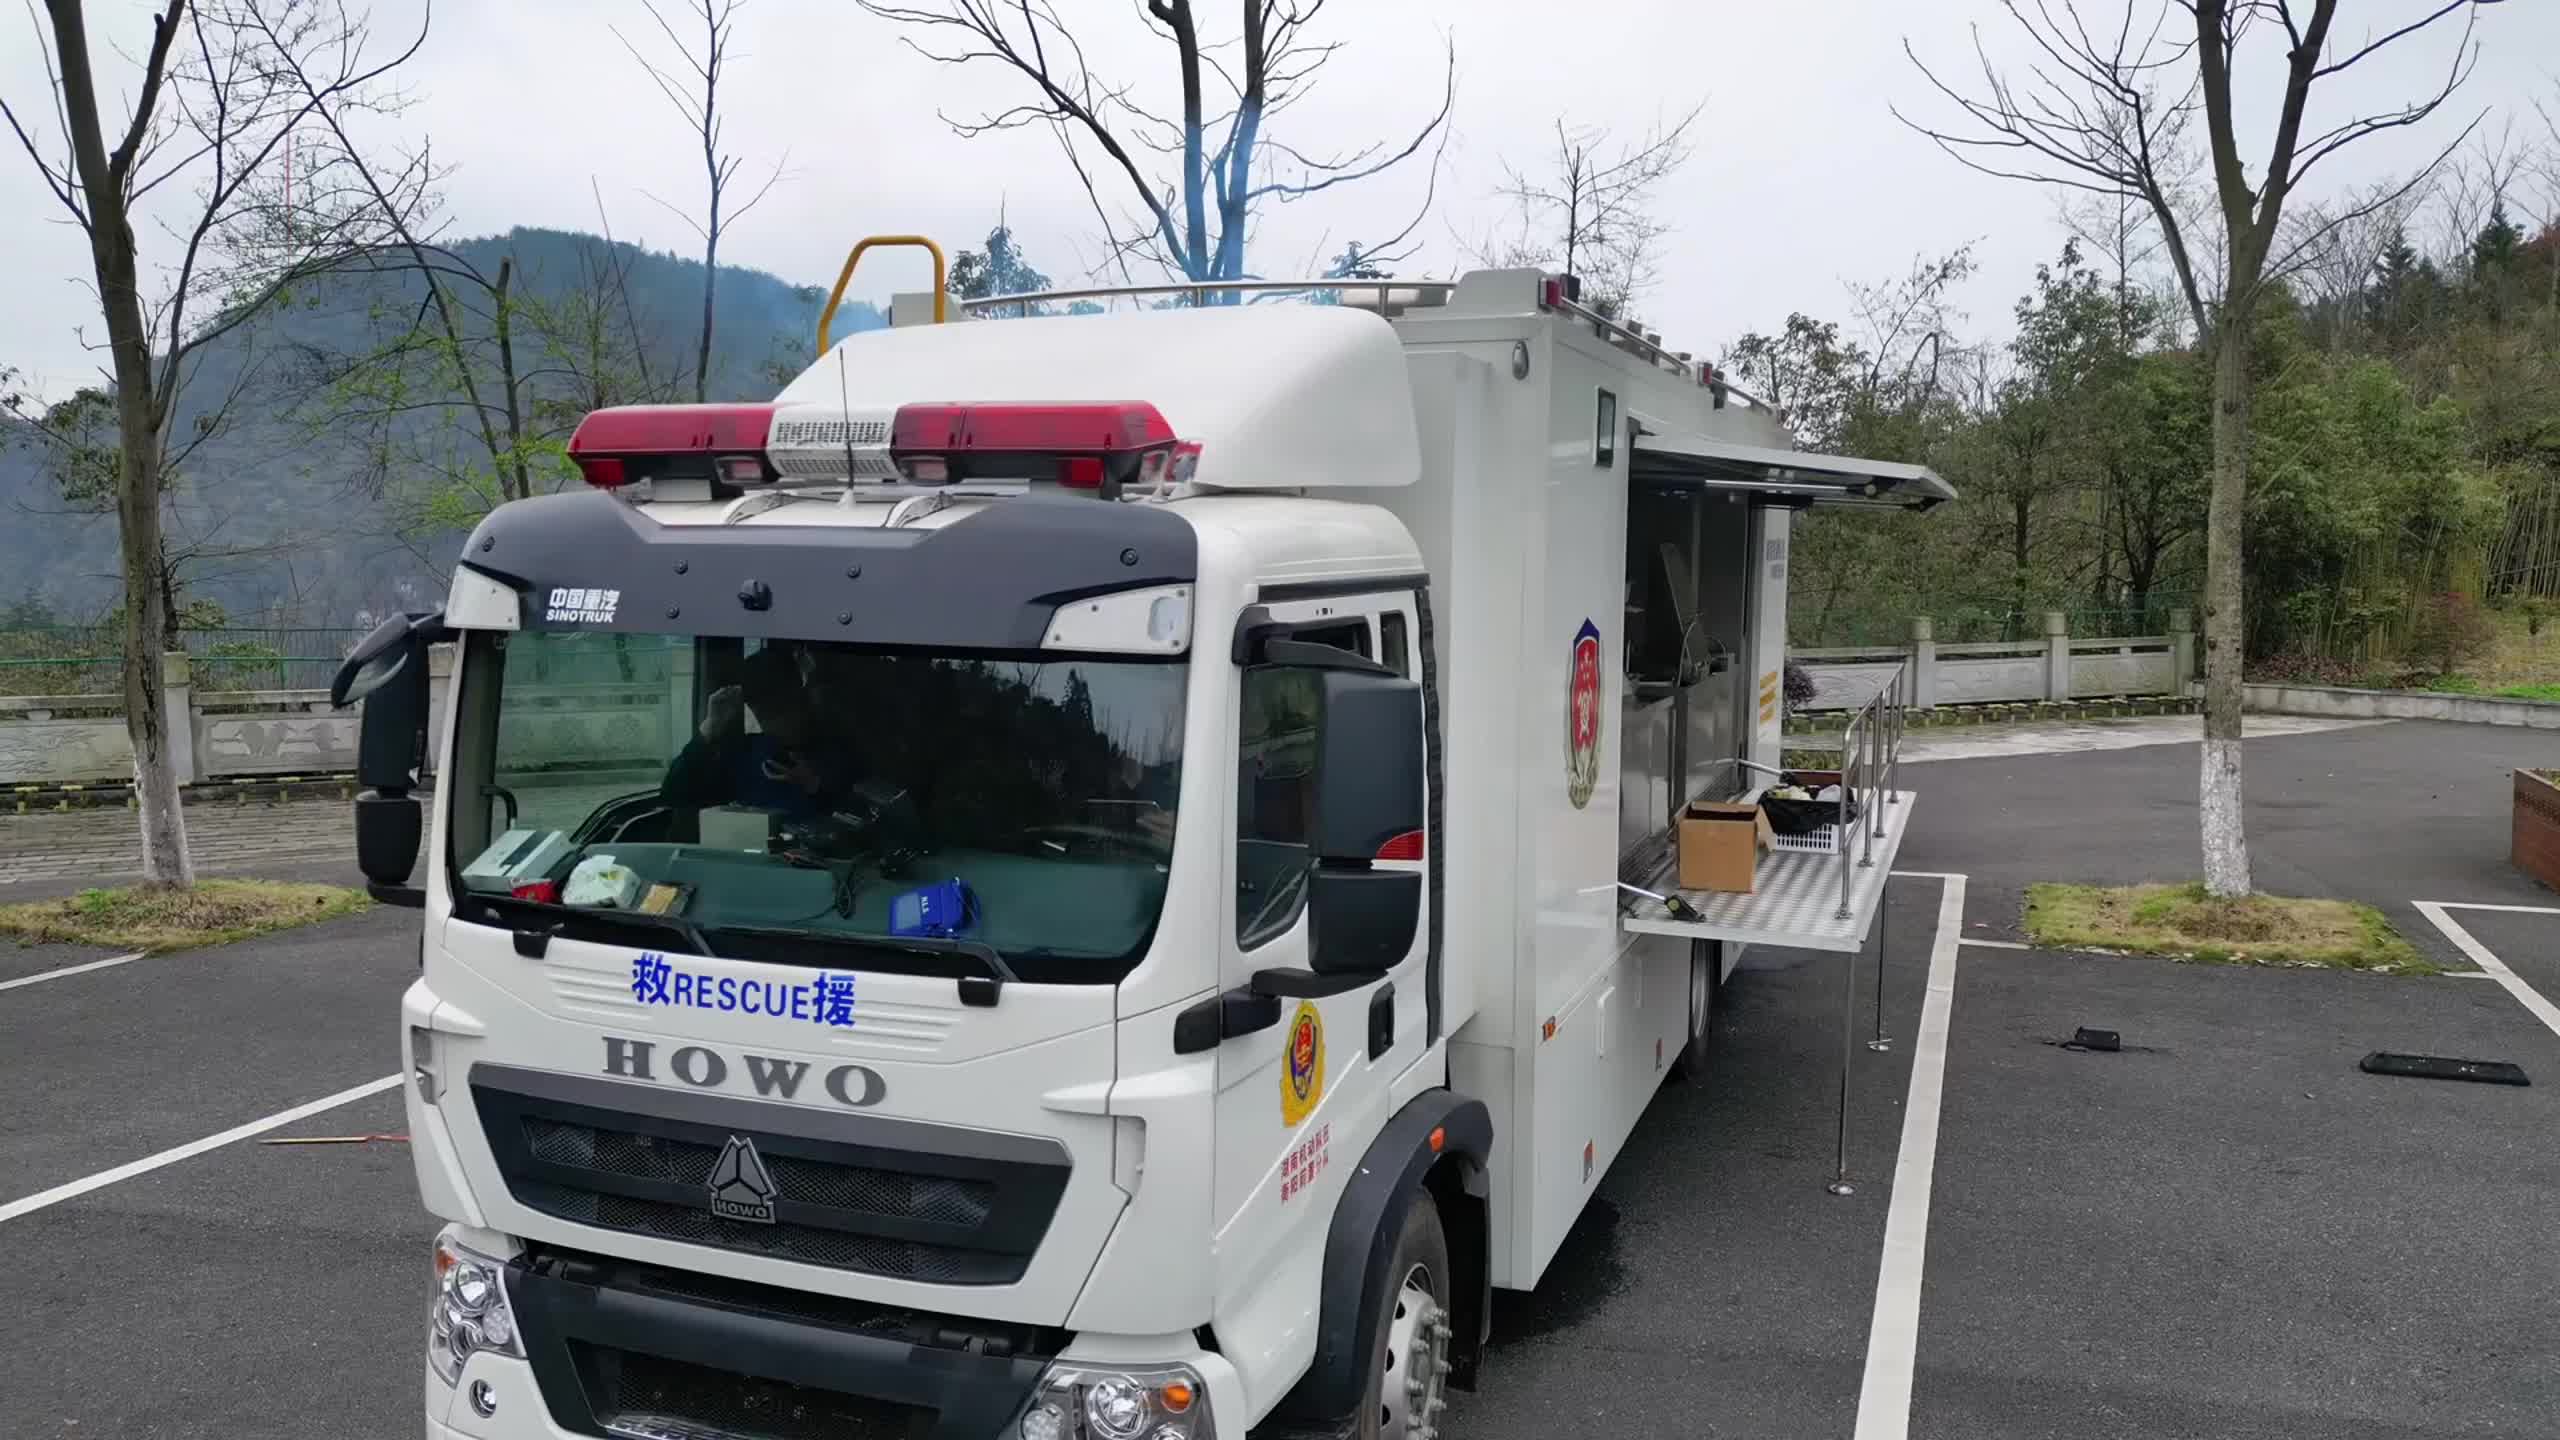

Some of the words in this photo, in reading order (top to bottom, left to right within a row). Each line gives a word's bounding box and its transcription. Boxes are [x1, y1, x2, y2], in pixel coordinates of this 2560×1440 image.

[549, 588, 620, 610] 中国重汽
[546, 610, 614, 623] SINOTRUK
[602, 1036, 887, 1107] HOWO
[716, 1199, 768, 1218] HOWO
